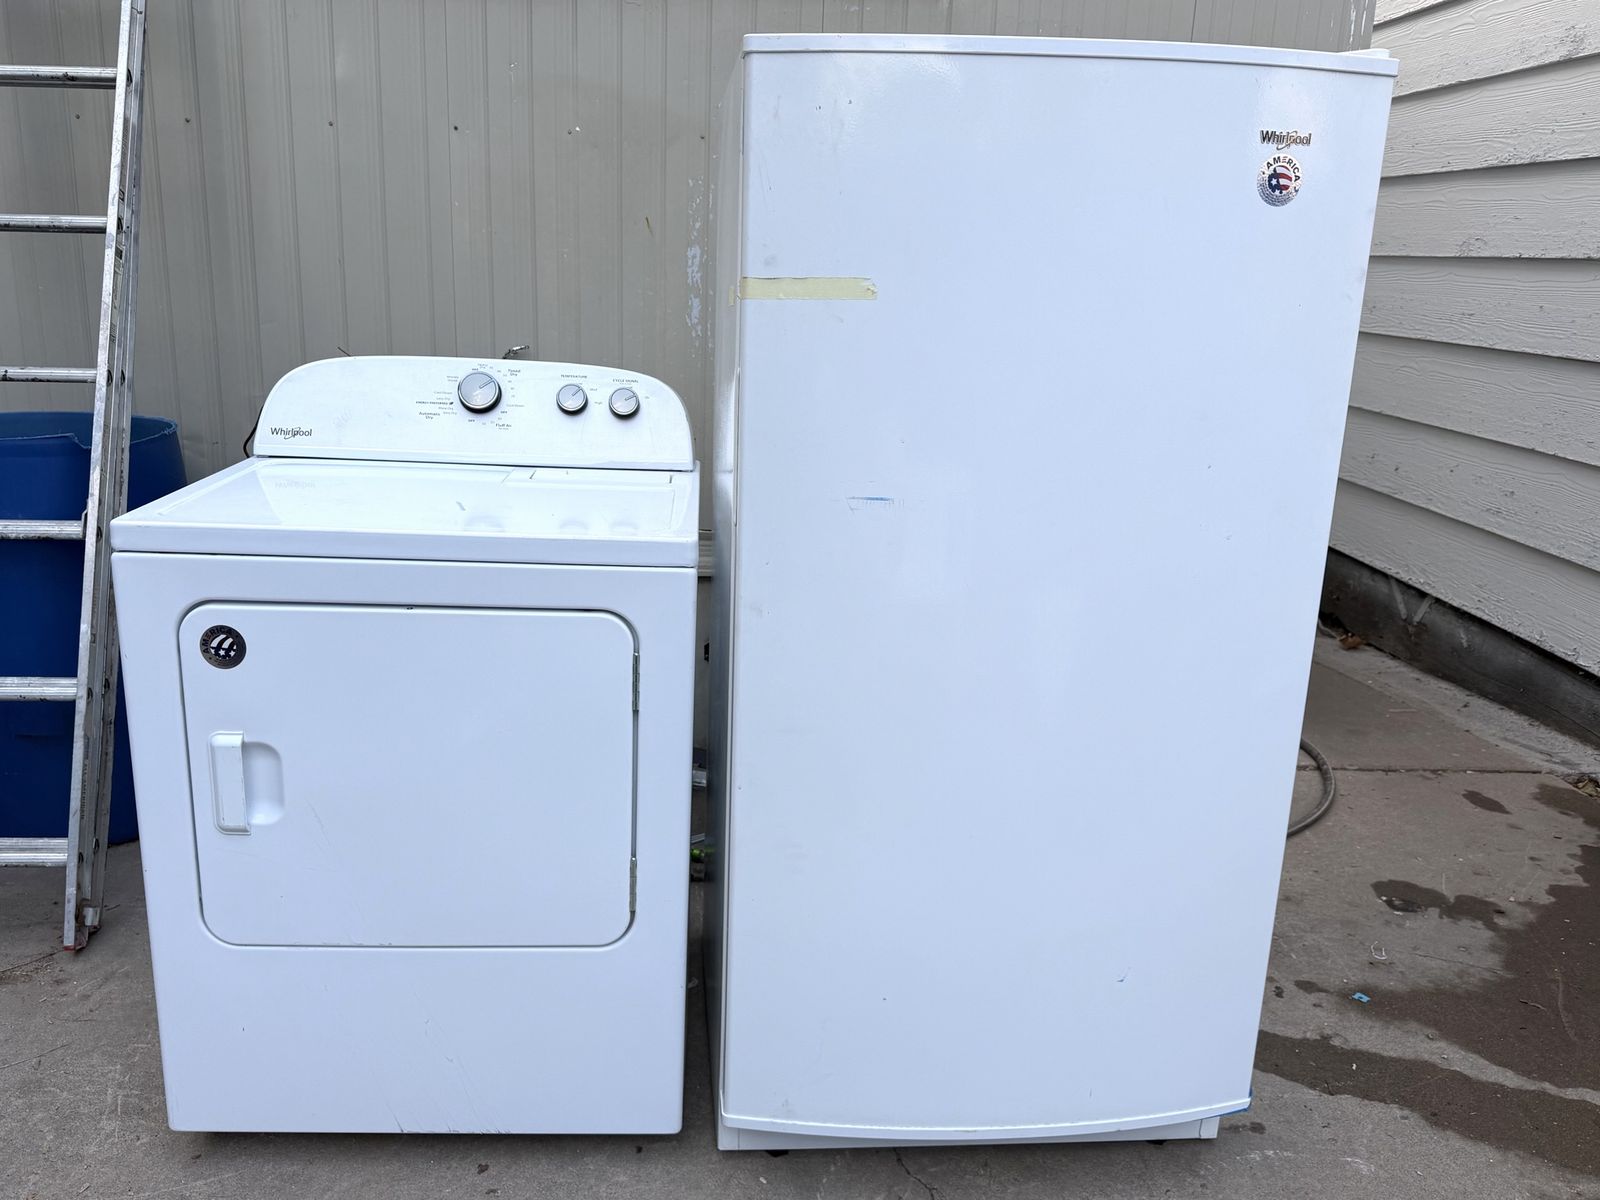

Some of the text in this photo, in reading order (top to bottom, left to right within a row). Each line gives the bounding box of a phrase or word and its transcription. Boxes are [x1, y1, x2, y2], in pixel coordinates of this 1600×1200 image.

[1260, 130, 1311, 150] Whirlpool
[1266, 156, 1301, 182] AMERICA
[270, 427, 312, 439] Whirlpool
